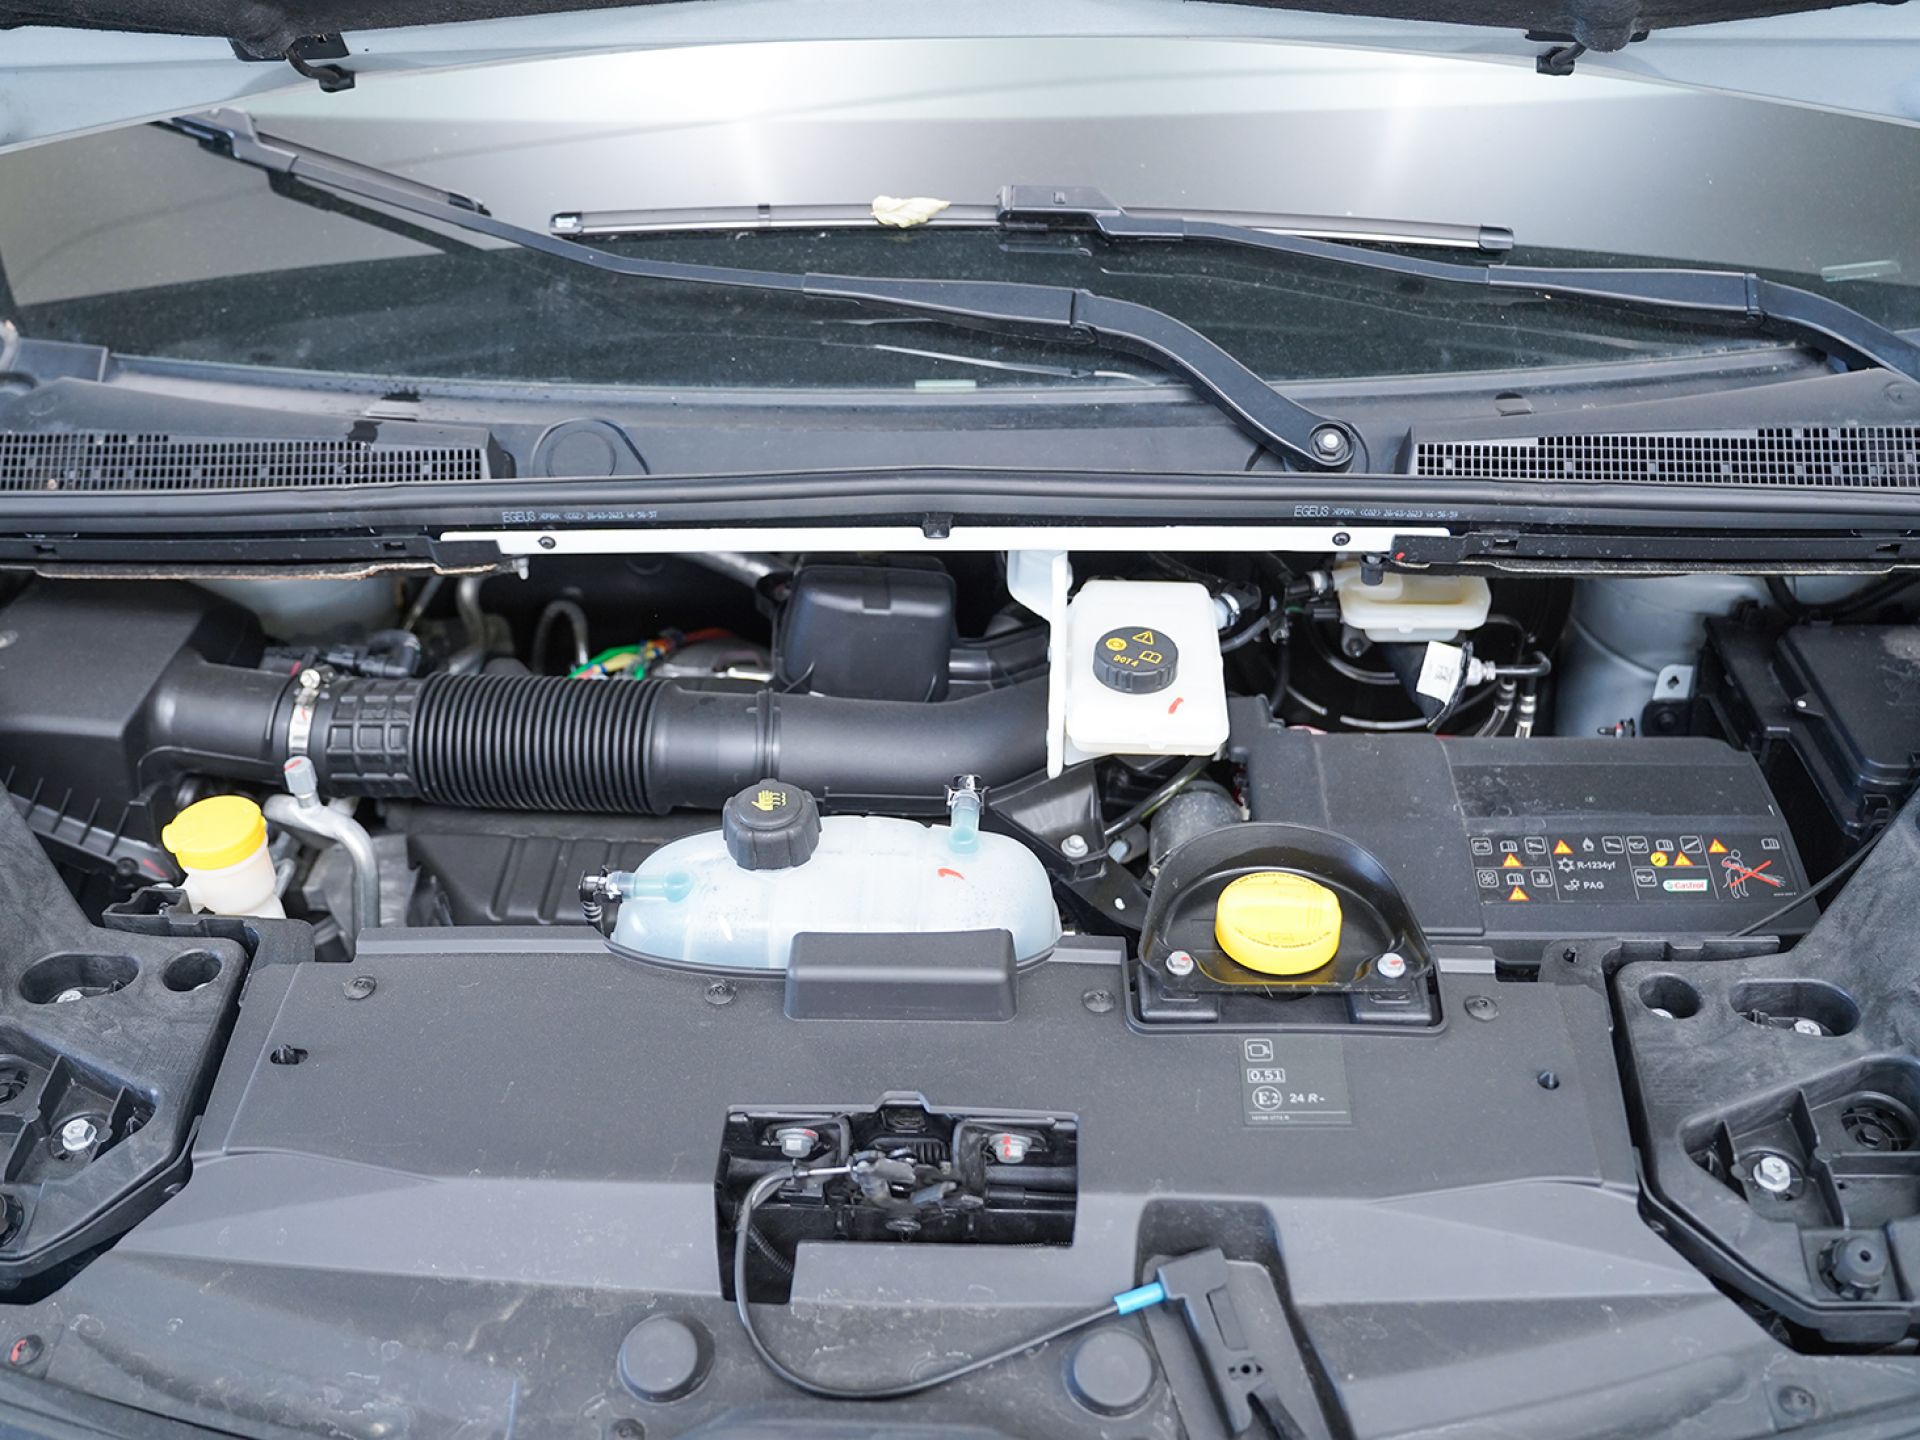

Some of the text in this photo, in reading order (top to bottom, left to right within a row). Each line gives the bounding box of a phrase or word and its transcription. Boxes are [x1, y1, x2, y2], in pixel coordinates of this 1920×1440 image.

[1293, 505, 1329, 517] EGEUS
[502, 511, 536, 523] EGEUS
[1576, 860, 1616, 871] R-1234yf
[1583, 881, 1605, 890] PAG
[1674, 881, 1705, 890] Castrol
[1289, 1092, 1305, 1104] 24
